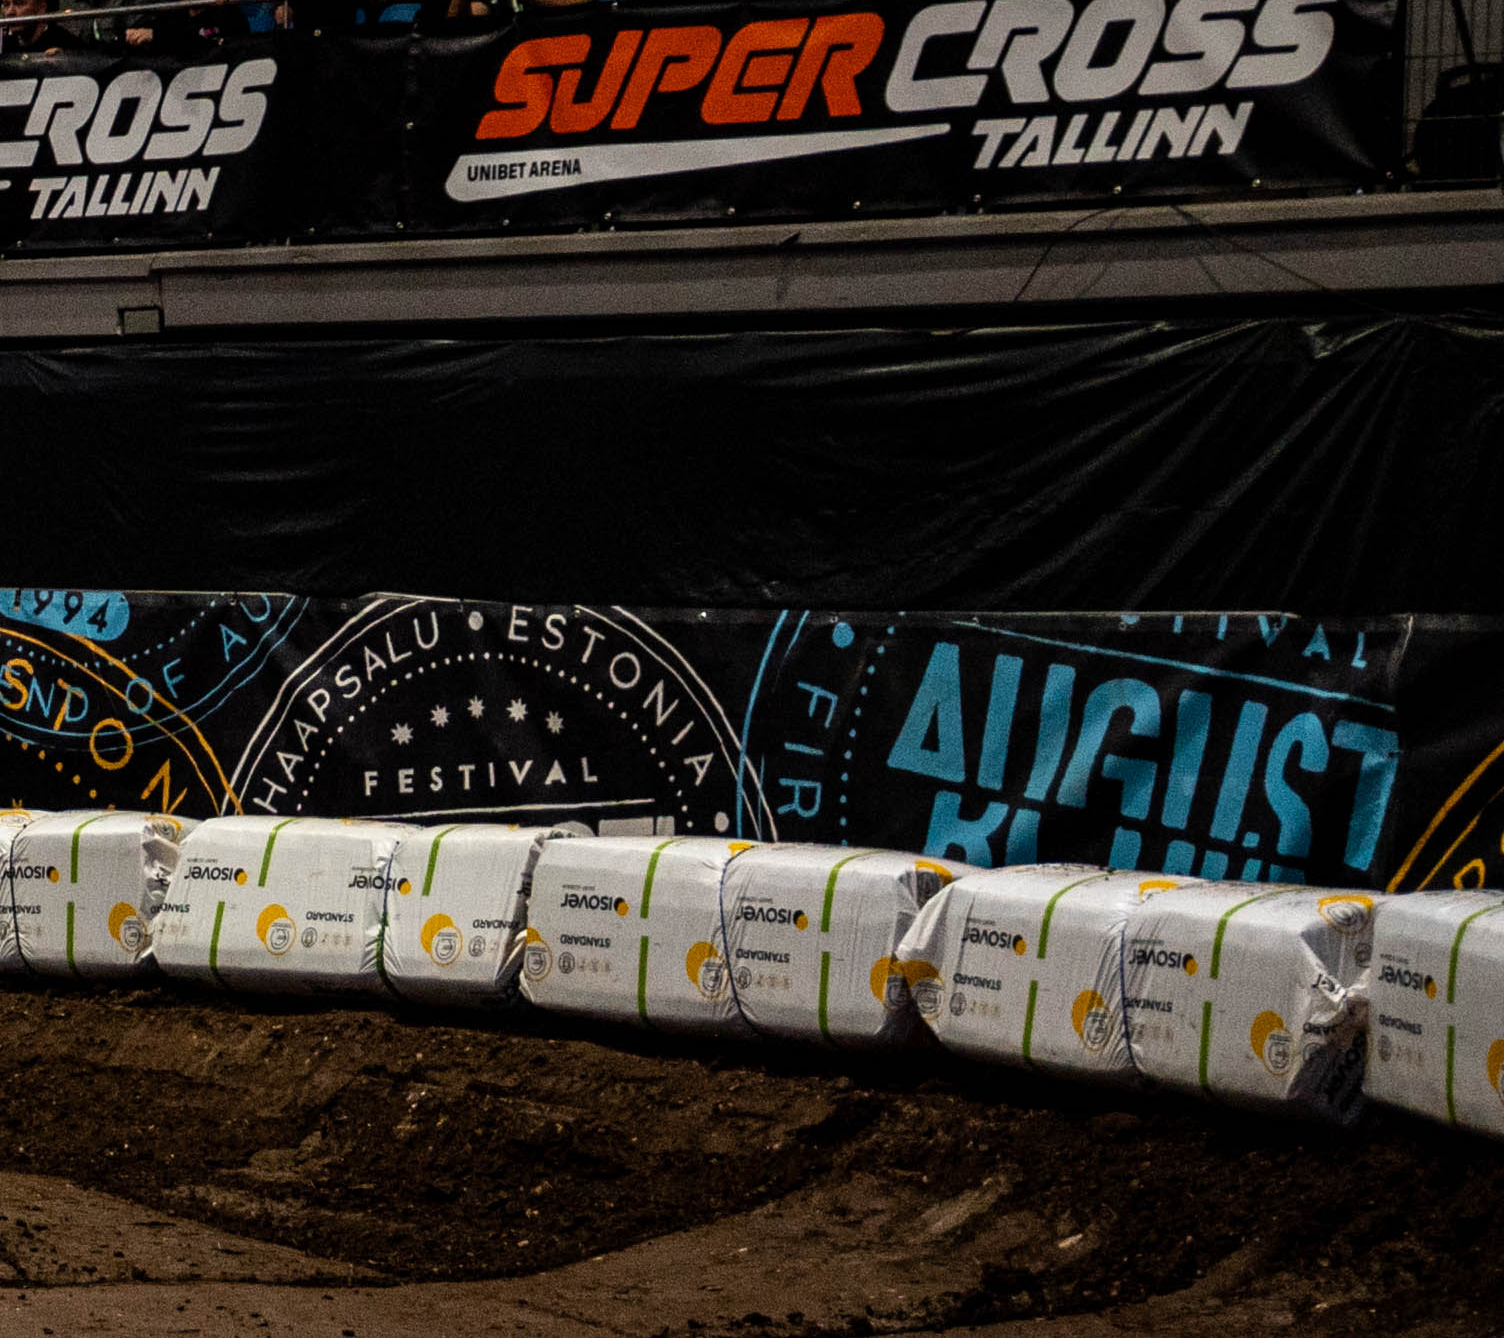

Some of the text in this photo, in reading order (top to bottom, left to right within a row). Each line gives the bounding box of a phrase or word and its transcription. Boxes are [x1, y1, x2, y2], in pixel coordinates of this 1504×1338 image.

[474, 11, 885, 140] SUPER
[972, 102, 1253, 169] TALLINN
[29, 167, 221, 220] TALLINN
[467, 158, 582, 183] UNIBET ARENA
[254, 605, 714, 813] HAAPSALU ESTONIA
[365, 757, 598, 796] FESTIVAL
[887, 641, 1399, 871] AUGUST
[305, 910, 355, 923] STANDARD
[560, 933, 611, 949] STANDARD
